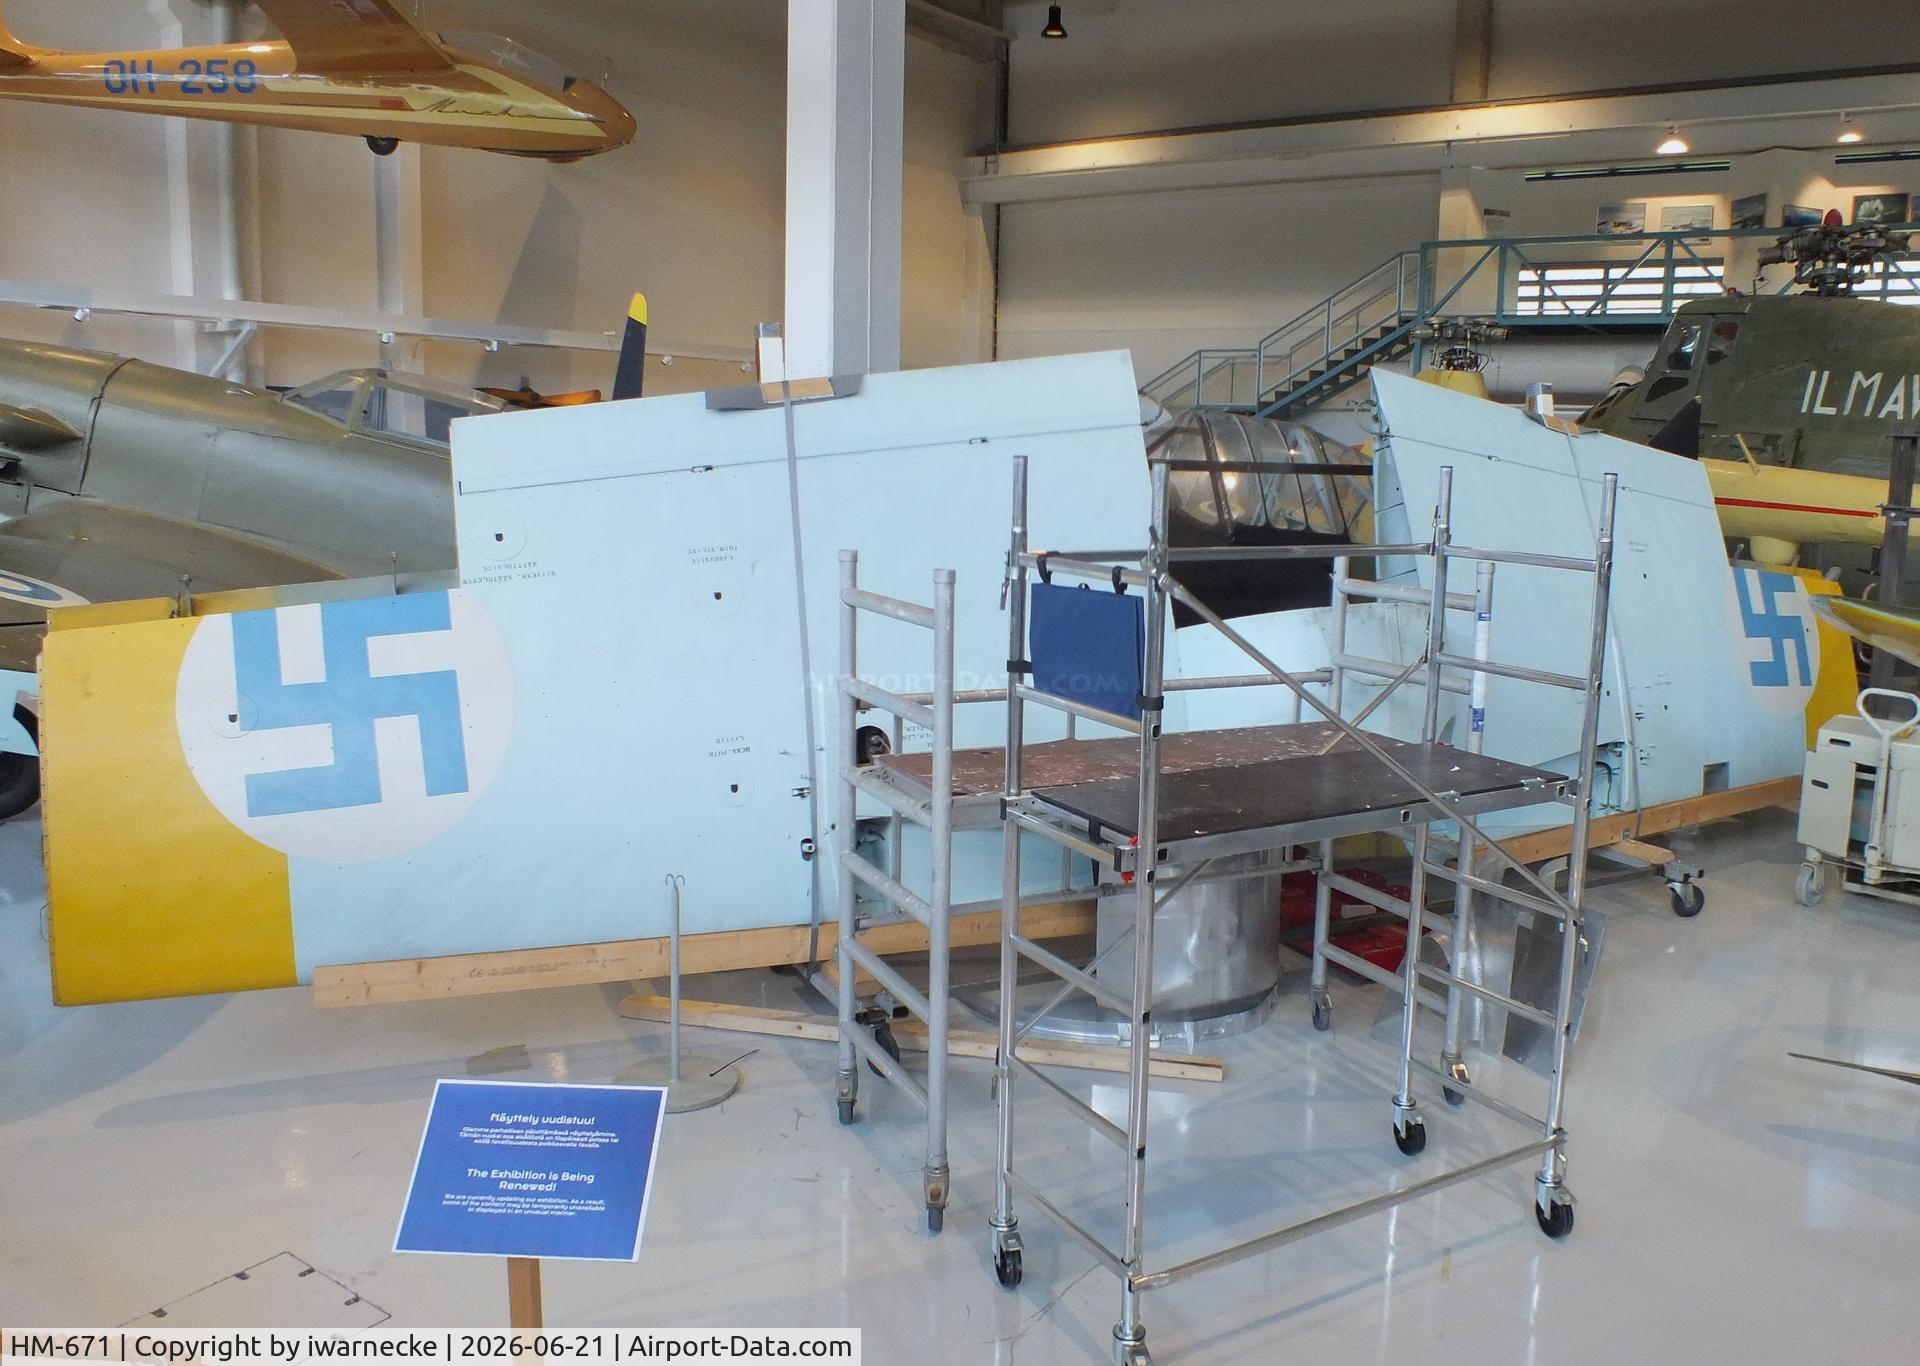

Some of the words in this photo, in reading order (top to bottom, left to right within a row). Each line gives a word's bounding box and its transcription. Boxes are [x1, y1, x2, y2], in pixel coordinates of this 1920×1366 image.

[104, 59, 257, 94] OH-258
[490, 1112, 540, 1125] Näyttely
[541, 1115, 595, 1125] uudistuu!
[467, 1168, 489, 1178] The
[491, 1169, 546, 1180] Exhibition
[548, 1171, 559, 1181] is
[561, 1171, 595, 1184] Being
[499, 1180, 557, 1192] Renewed!
